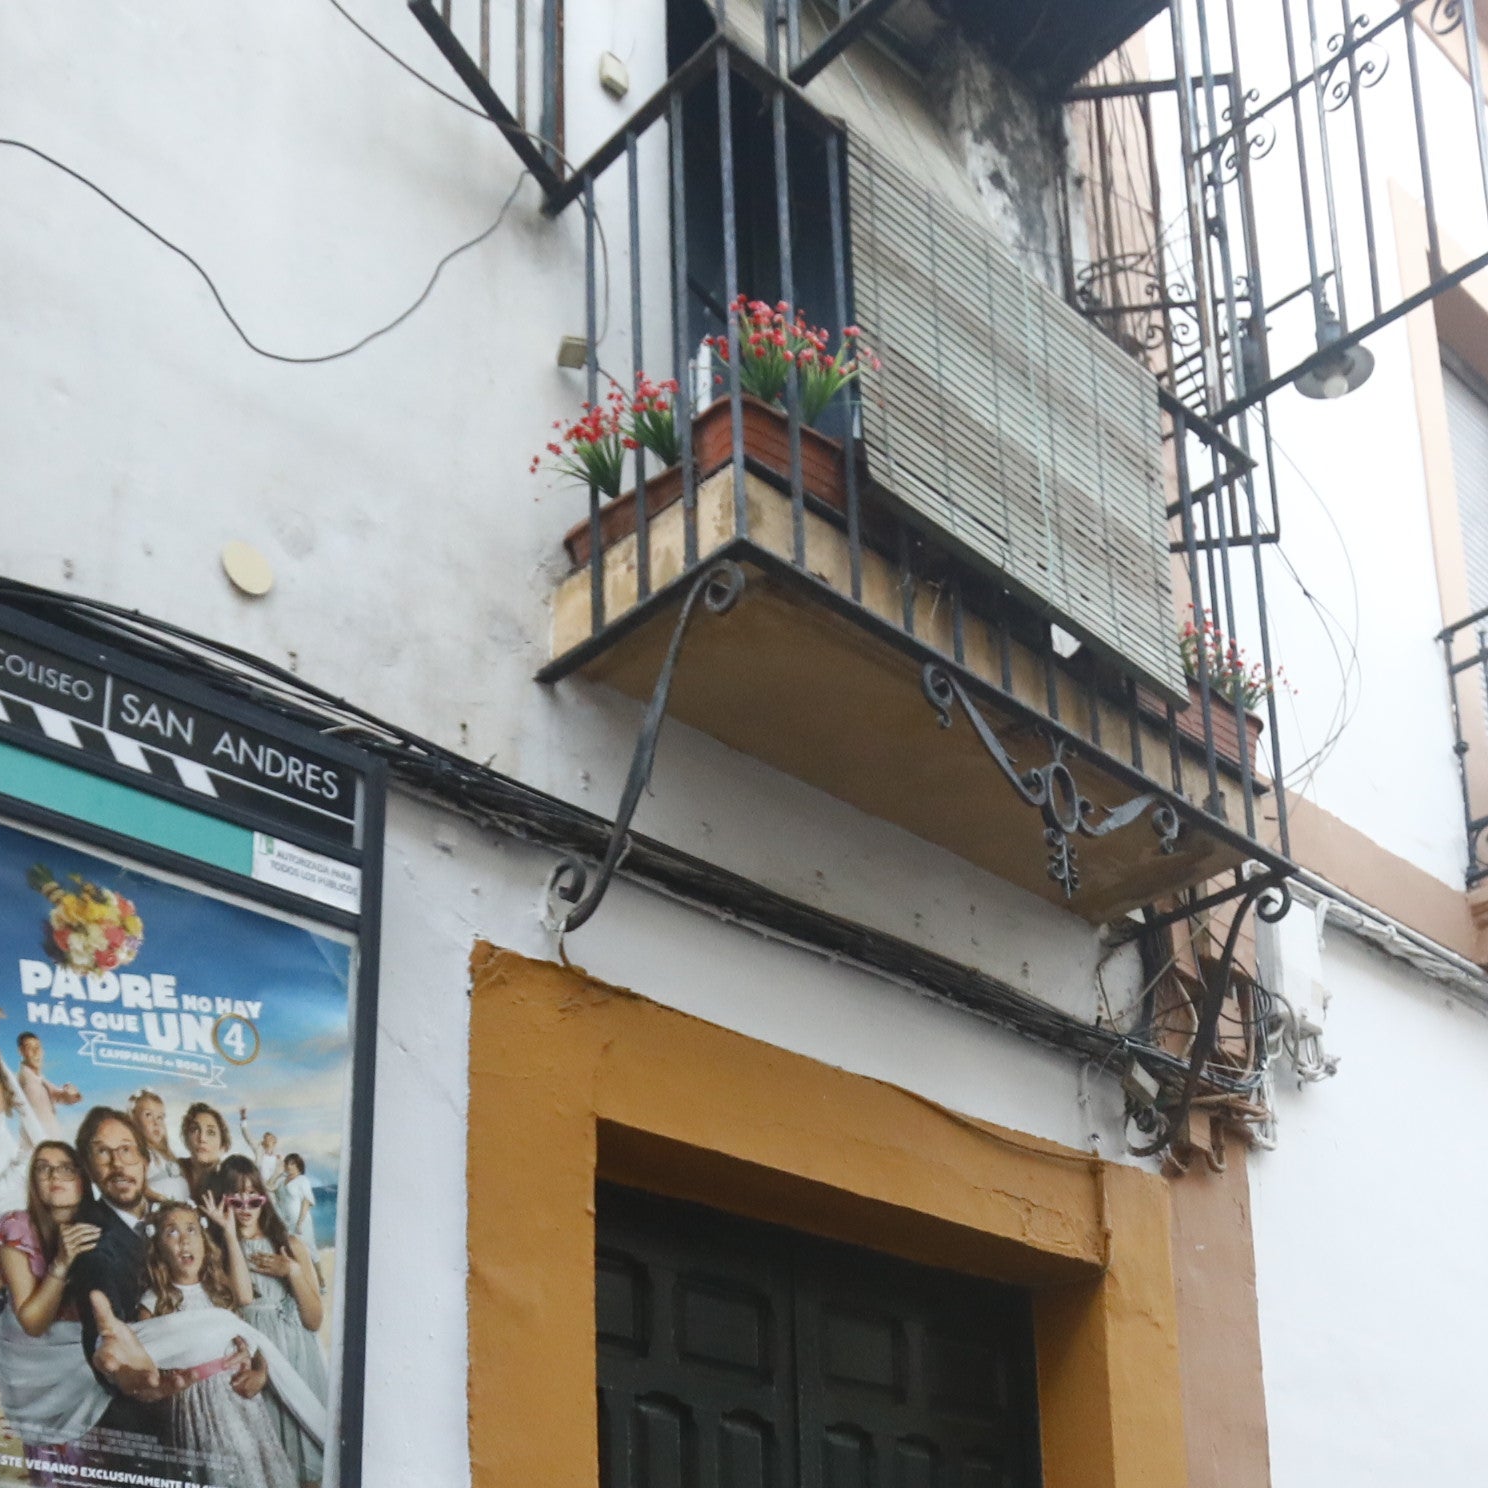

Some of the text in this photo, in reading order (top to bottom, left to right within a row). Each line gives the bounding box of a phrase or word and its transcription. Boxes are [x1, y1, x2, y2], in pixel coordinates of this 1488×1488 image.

[120, 693, 195, 746] SAN
[212, 731, 340, 800] ANDRES
[19, 958, 263, 1019] PADRE NO HAY
[27, 1000, 87, 1028] MÁS
[90, 1011, 140, 1033] QUE
[25, 1458, 79, 1476] VERANO
